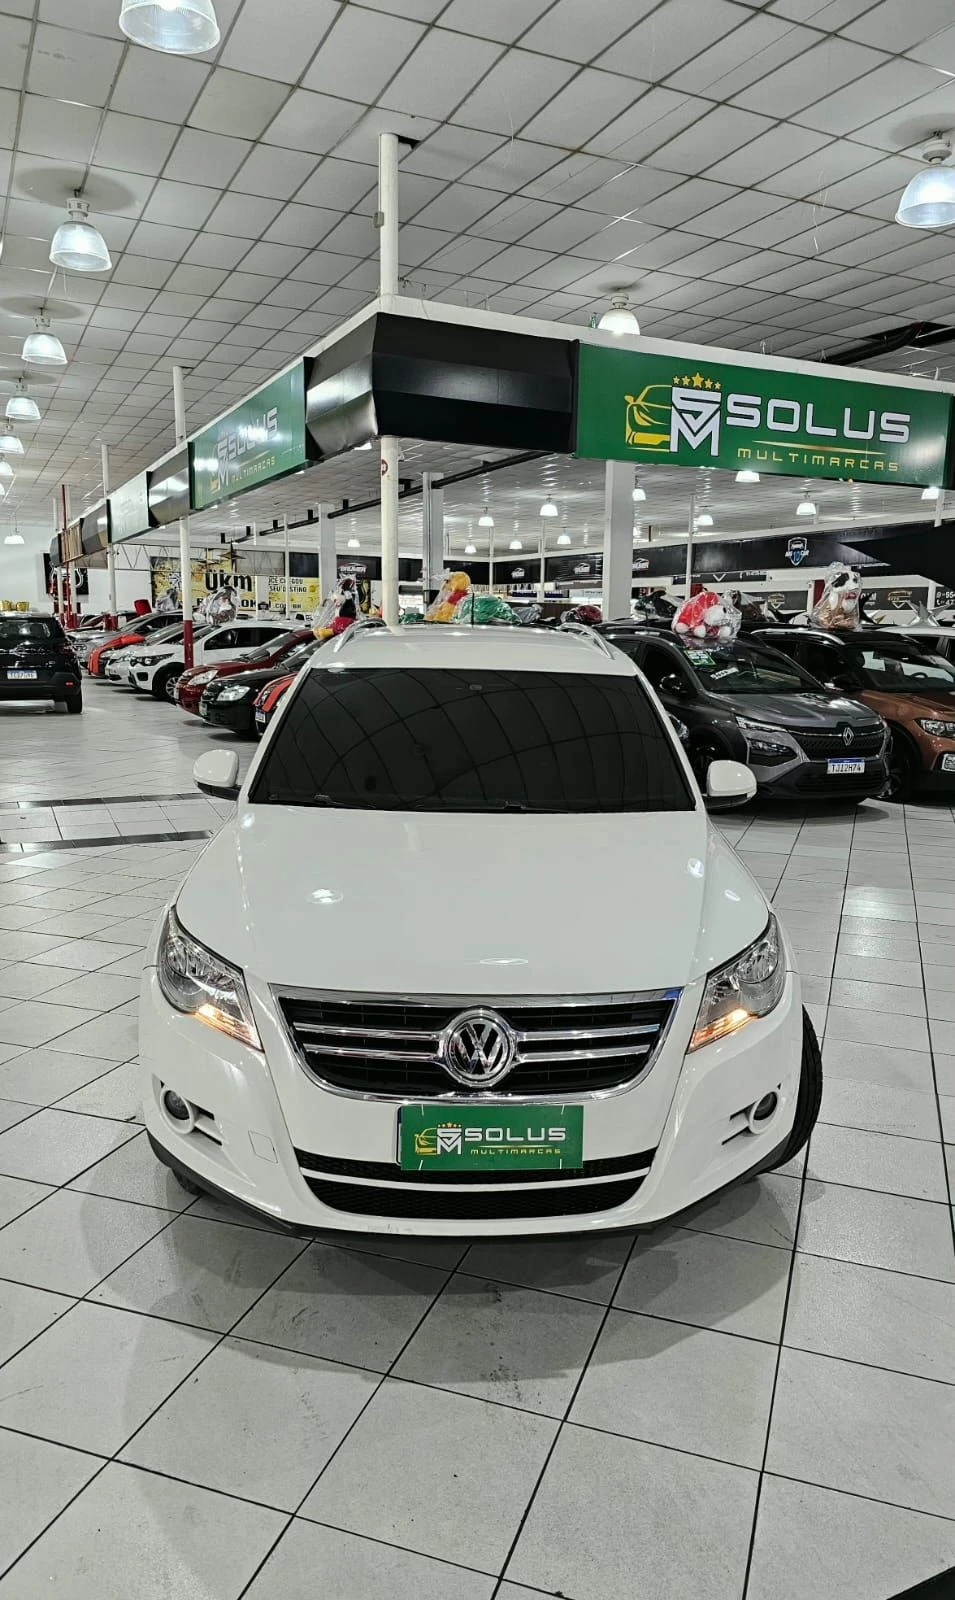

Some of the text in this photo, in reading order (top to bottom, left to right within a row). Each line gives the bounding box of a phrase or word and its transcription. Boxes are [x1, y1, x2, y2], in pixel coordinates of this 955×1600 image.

[726, 392, 912, 444] SOLUS
[737, 447, 900, 473] MULTIMARCAS
[464, 1127, 567, 1142] SOLUS
